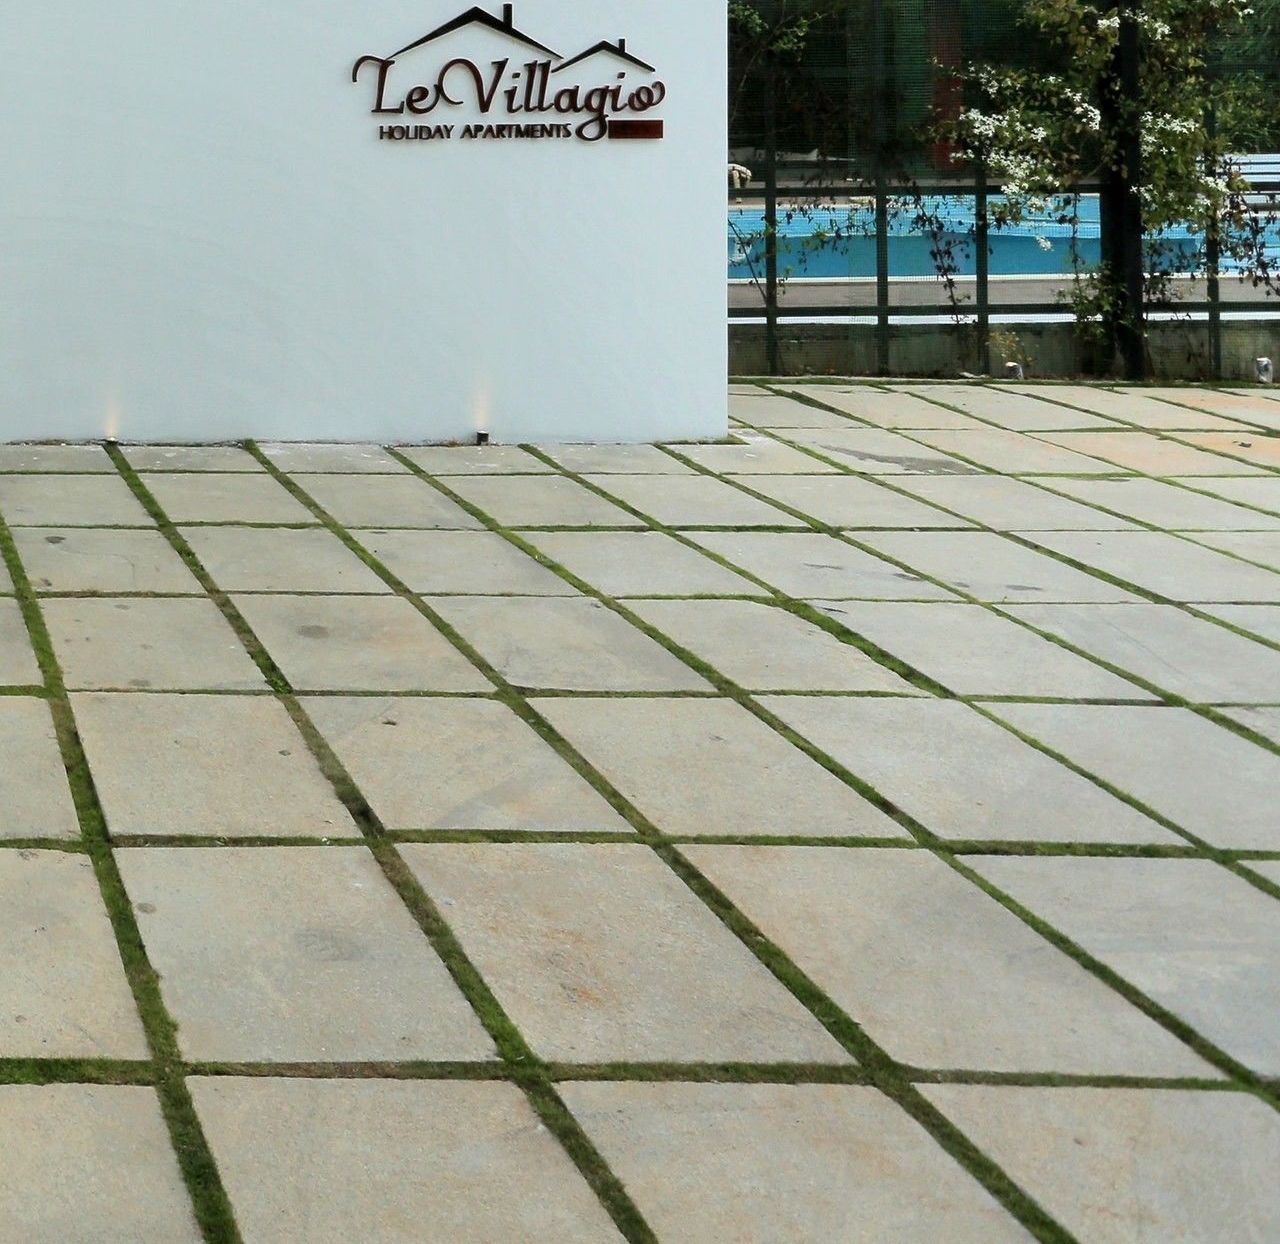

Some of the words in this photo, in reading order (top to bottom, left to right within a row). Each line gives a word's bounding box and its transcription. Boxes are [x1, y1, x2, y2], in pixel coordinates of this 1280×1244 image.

[352, 55, 439, 114] Le
[438, 57, 666, 141] Villagio
[379, 124, 455, 140] HOLIDAY
[460, 122, 572, 139] APARTMENTS
